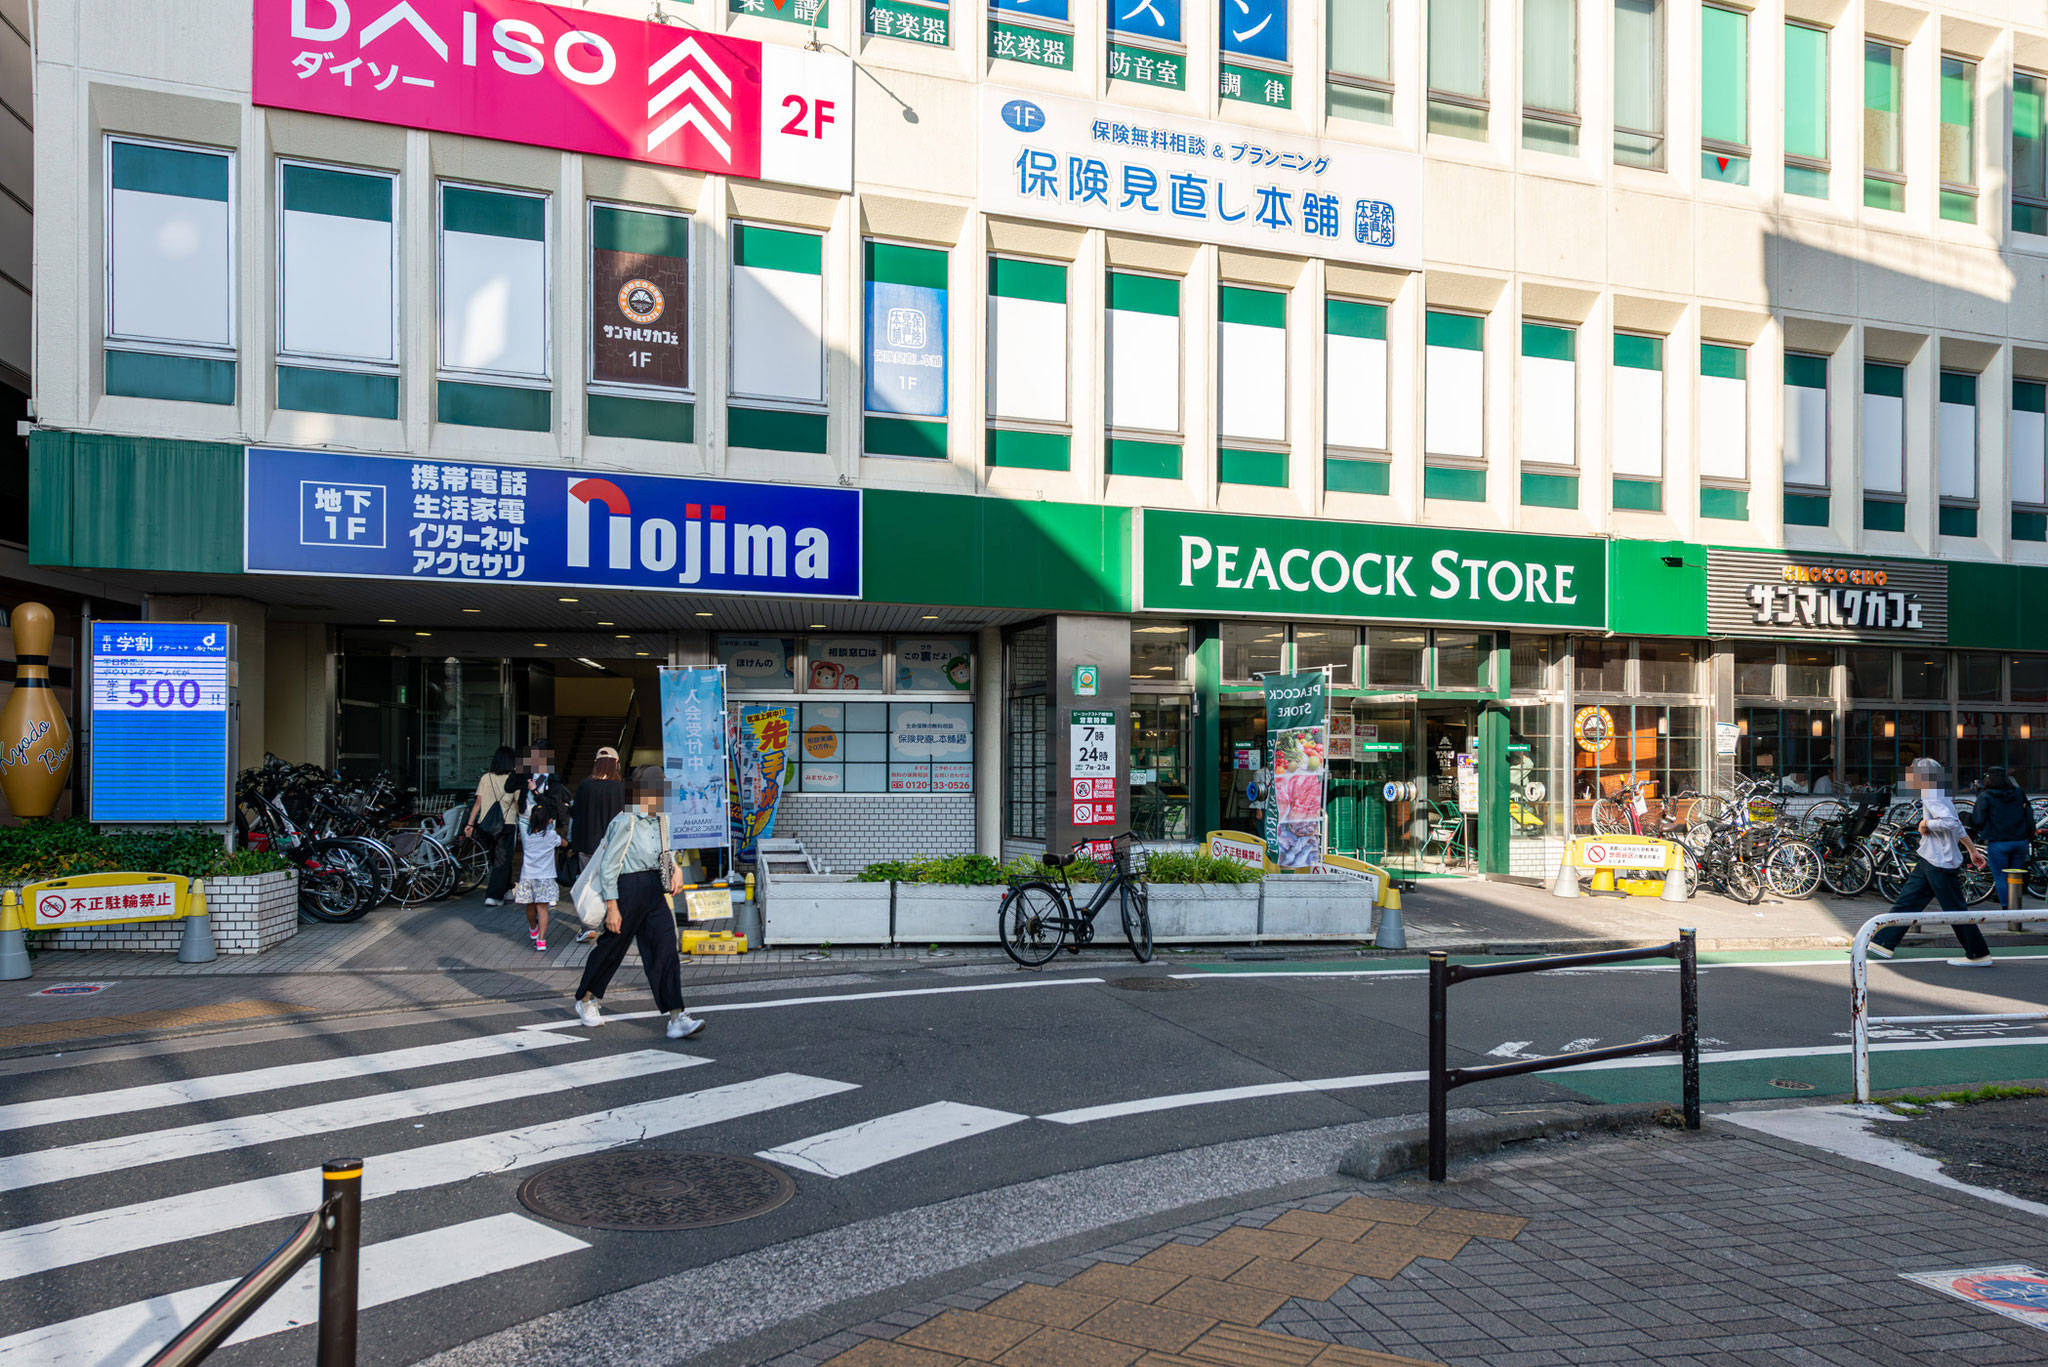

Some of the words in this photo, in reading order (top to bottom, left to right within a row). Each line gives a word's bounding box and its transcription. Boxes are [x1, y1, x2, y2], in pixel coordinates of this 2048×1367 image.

[869, 7, 947, 44] 管楽器
[291, 0, 617, 85] DAISO
[993, 31, 1066, 65] 弦楽器
[291, 50, 435, 91] ダイソー
[1109, 51, 1179, 85] 防音室
[780, 94, 836, 139] 2F
[1013, 104, 1036, 128] 1F
[1092, 120, 1207, 156] 保険無料相談
[1231, 143, 1331, 174] プランニング
[1016, 148, 1340, 238] 保険見直し本舗
[603, 325, 679, 345] サンマルクカフェ
[628, 351, 652, 368] 1F
[899, 375, 918, 390] 1F
[411, 464, 527, 497] 携帯電話
[314, 487, 372, 514] 地下
[412, 493, 526, 525] 生活家電
[325, 515, 366, 540] 1F
[409, 522, 529, 552] インターネット
[567, 476, 829, 584] nojima
[412, 550, 526, 578] アクセサリ
[1179, 535, 1417, 597] PEACOCK
[1430, 549, 1578, 605] STORE
[1783, 565, 1848, 584] CHOCO
[1849, 569, 1887, 586] CRO
[1750, 584, 1924, 629] サンマルクカフェ
[116, 632, 153, 652] 学割
[828, 647, 877, 657] 相談窓口は
[736, 658, 773, 667] ほけんの
[126, 679, 201, 708] 500
[1083, 727, 1104, 741] 7時
[1079, 747, 1108, 762] 24時
[1222, 844, 1262, 862] 不正駐輪禁止
[70, 892, 172, 912] 不正駐輪禁止
[698, 943, 736, 952] 駐輪禁止
